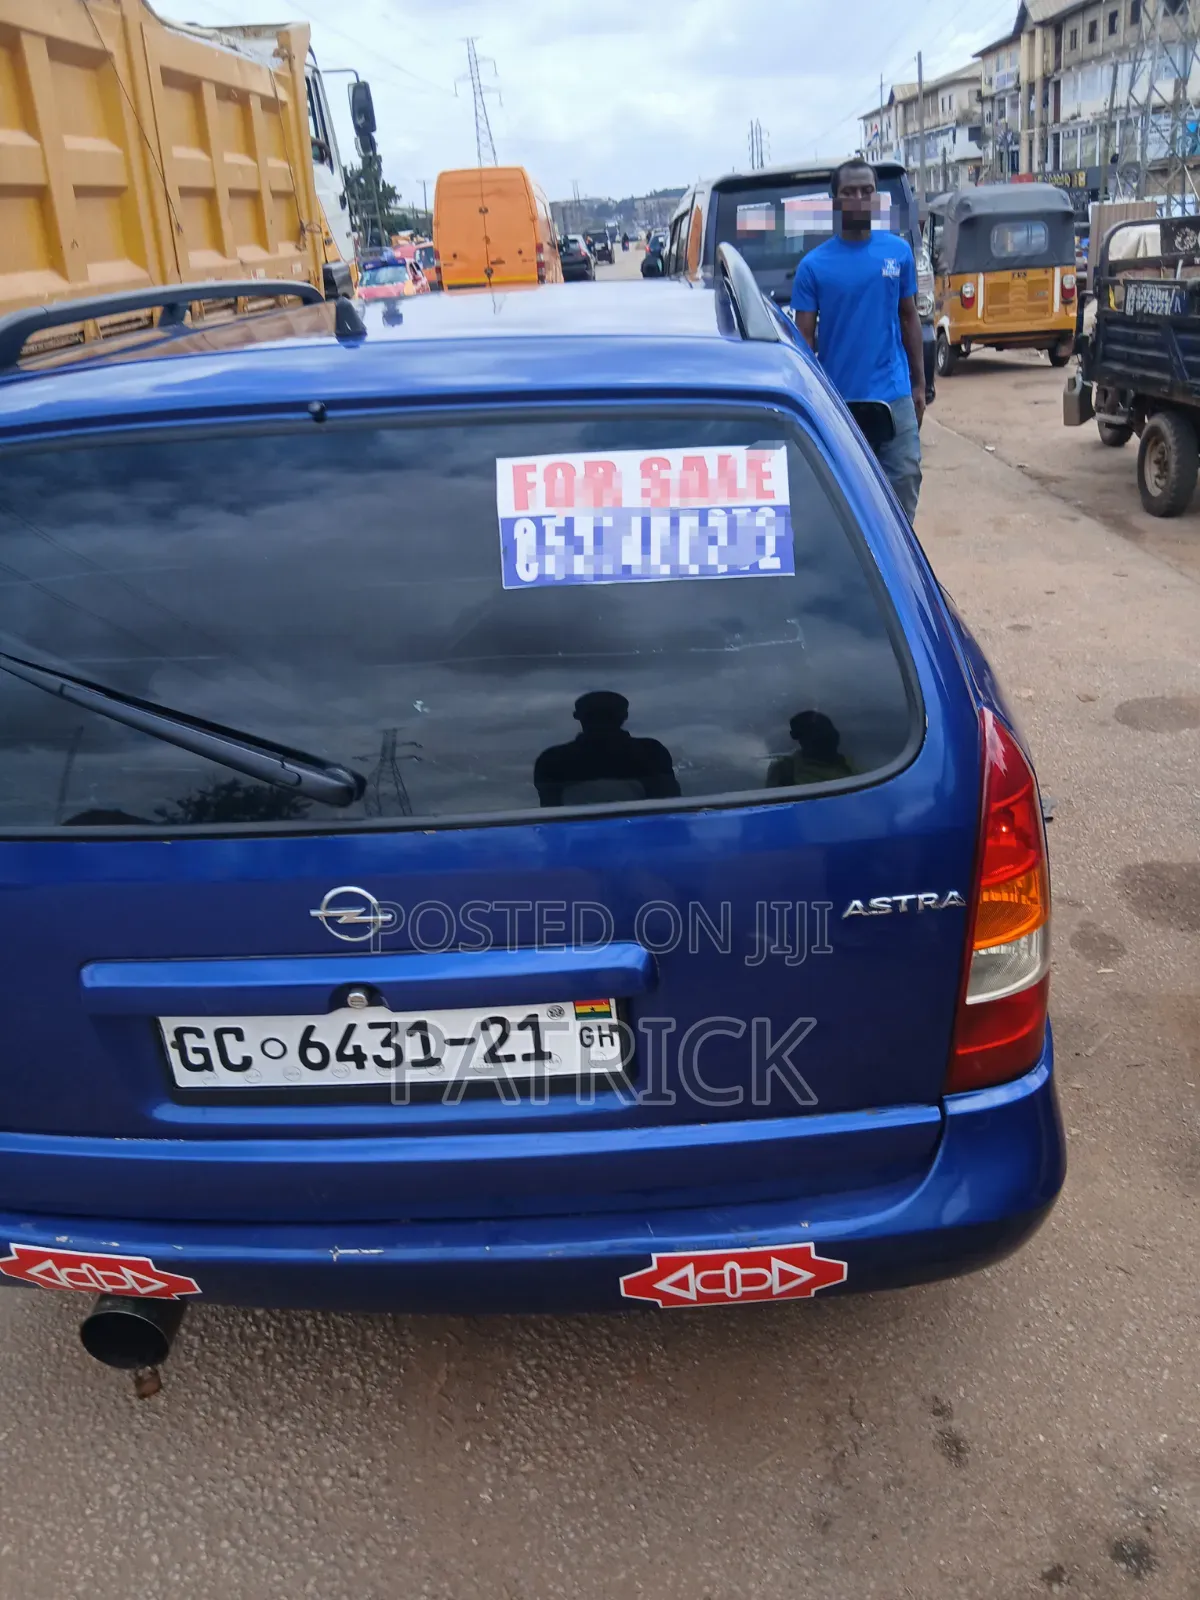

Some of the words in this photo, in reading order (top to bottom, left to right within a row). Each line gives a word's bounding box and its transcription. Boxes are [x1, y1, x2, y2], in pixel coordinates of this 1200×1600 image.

[842, 891, 967, 918] ASTRA
[173, 1026, 254, 1073] GC
[300, 1013, 553, 1071] 6431-21
[580, 1024, 616, 1049] GH
